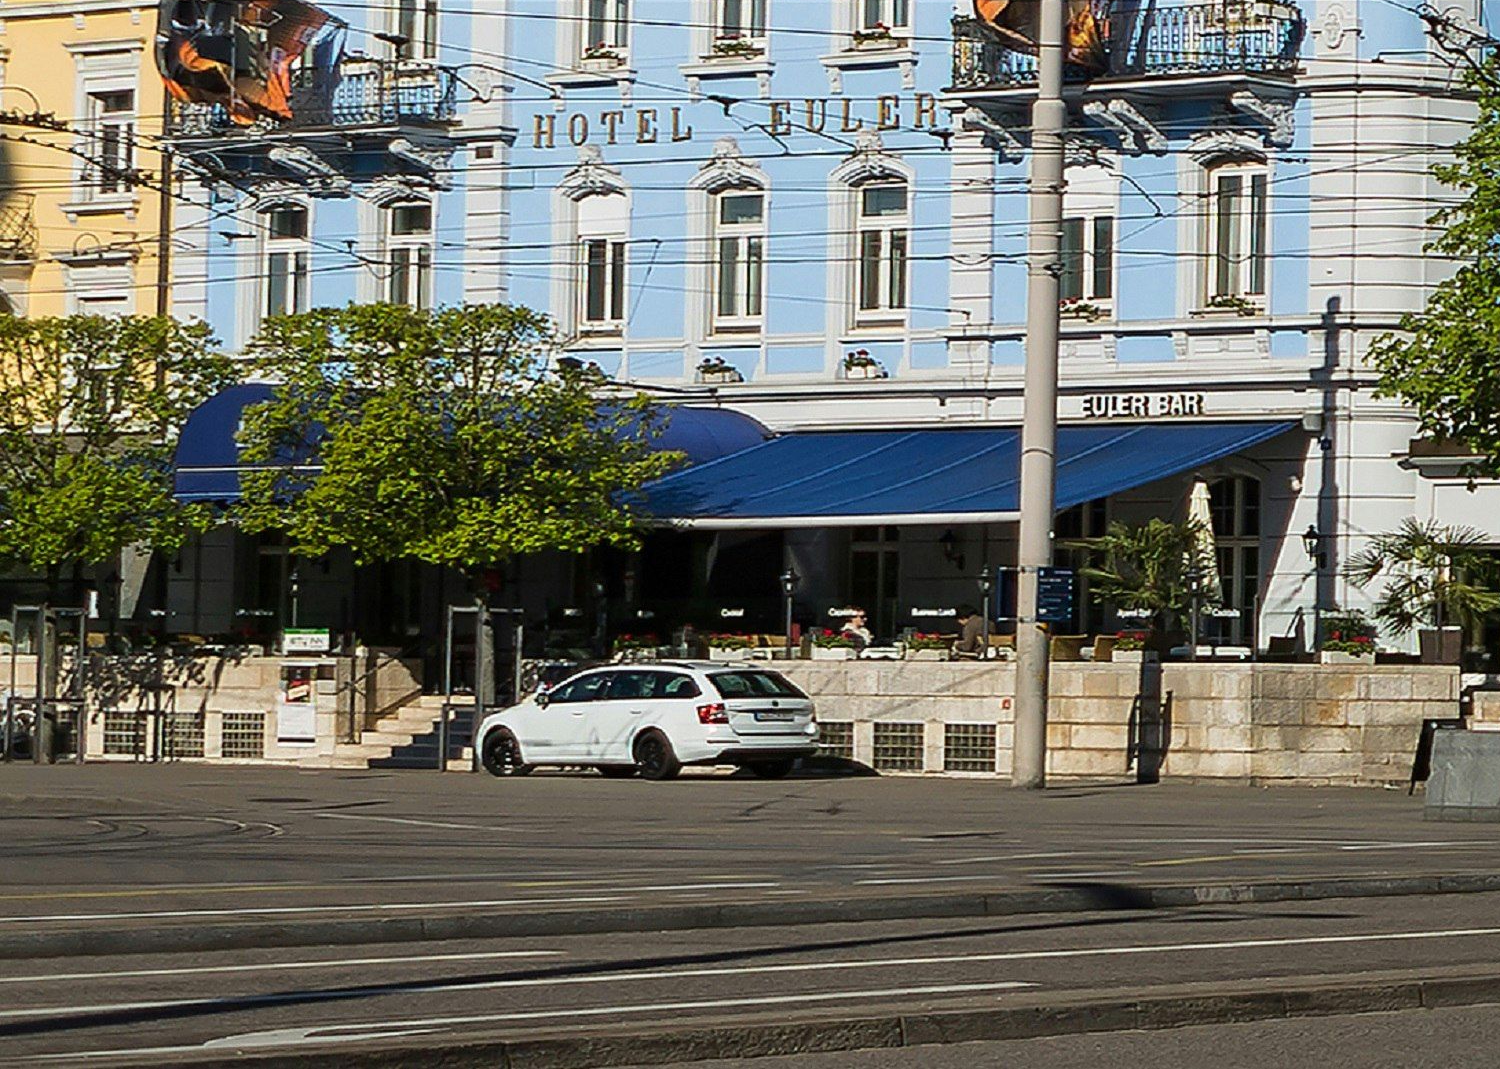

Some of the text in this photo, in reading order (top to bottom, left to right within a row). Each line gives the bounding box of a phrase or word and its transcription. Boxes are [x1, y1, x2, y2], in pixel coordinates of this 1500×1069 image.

[532, 92, 938, 149] HOTEL EULER
[1082, 394, 1206, 418] EULER BAR
